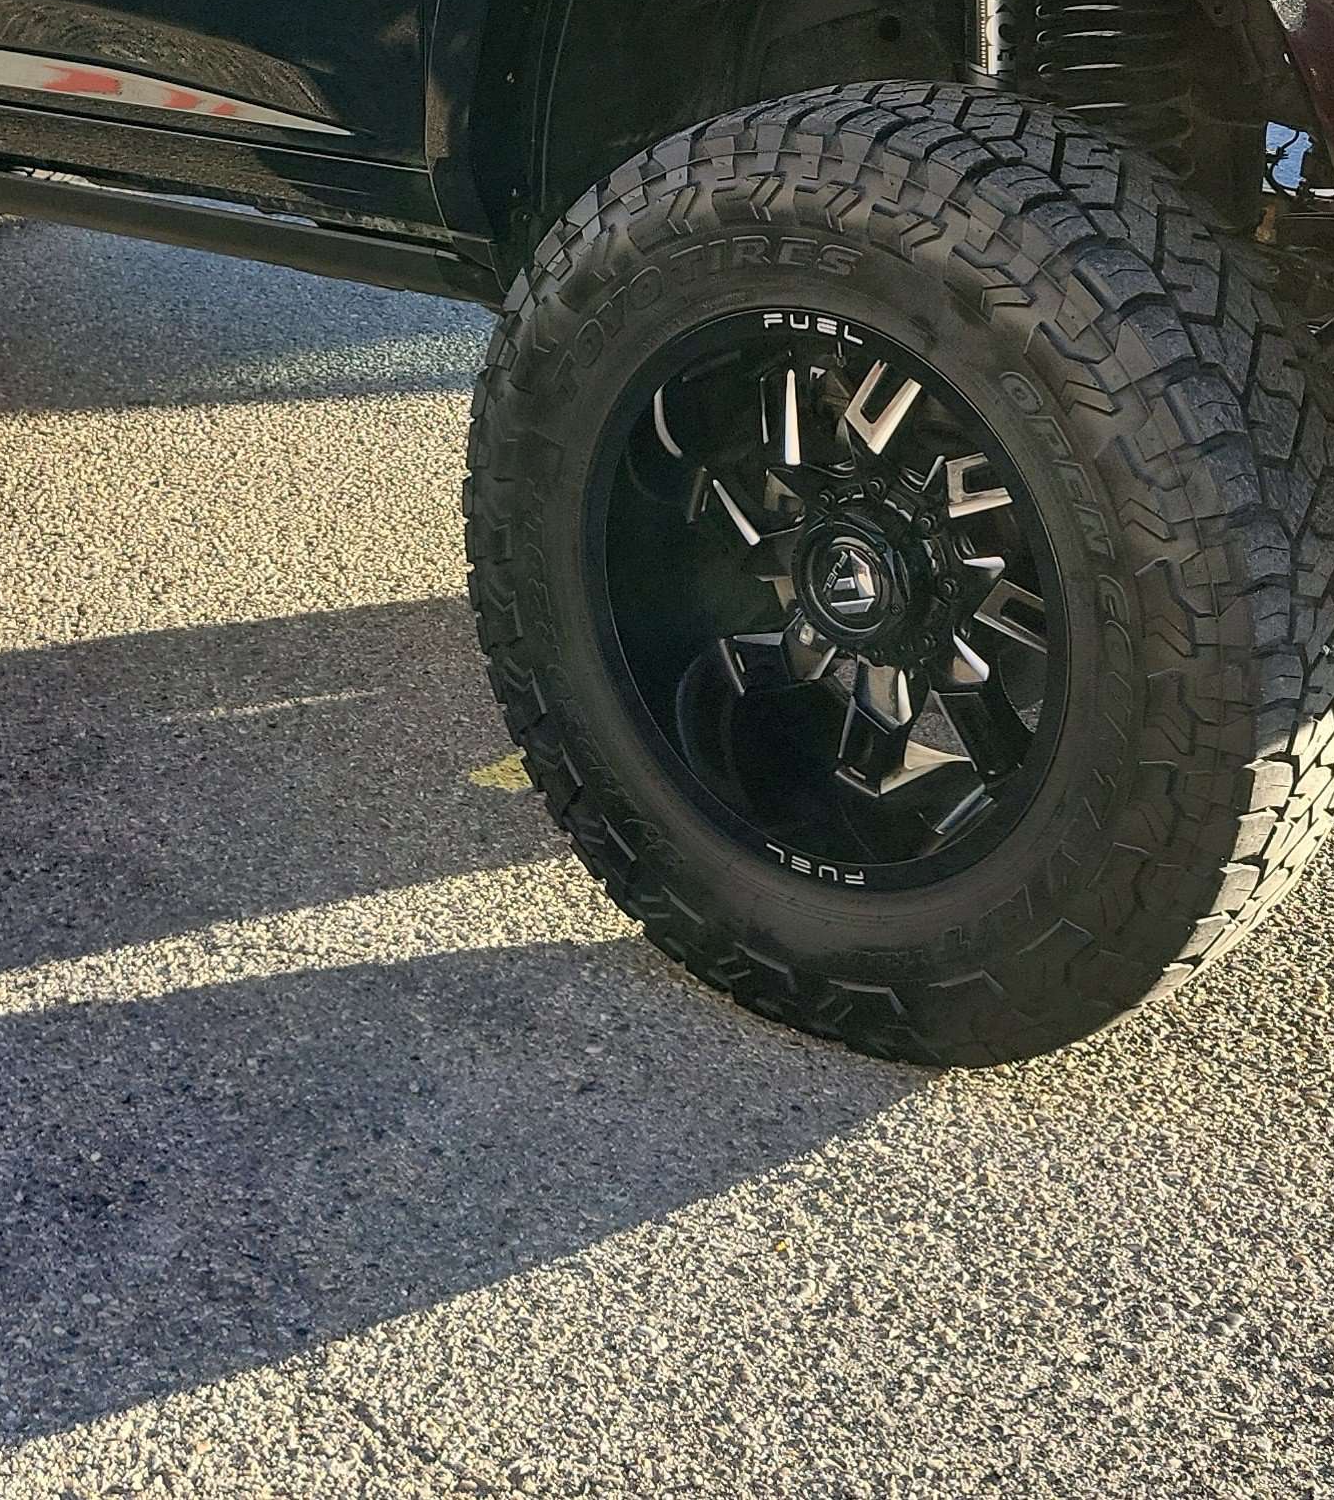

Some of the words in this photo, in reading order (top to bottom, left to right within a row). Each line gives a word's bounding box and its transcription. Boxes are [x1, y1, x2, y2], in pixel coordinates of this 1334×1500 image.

[669, 235, 864, 288] TIRES
[762, 312, 864, 345] FUEL
[1001, 370, 1116, 562] OPEN
[765, 841, 866, 886] FUEL
